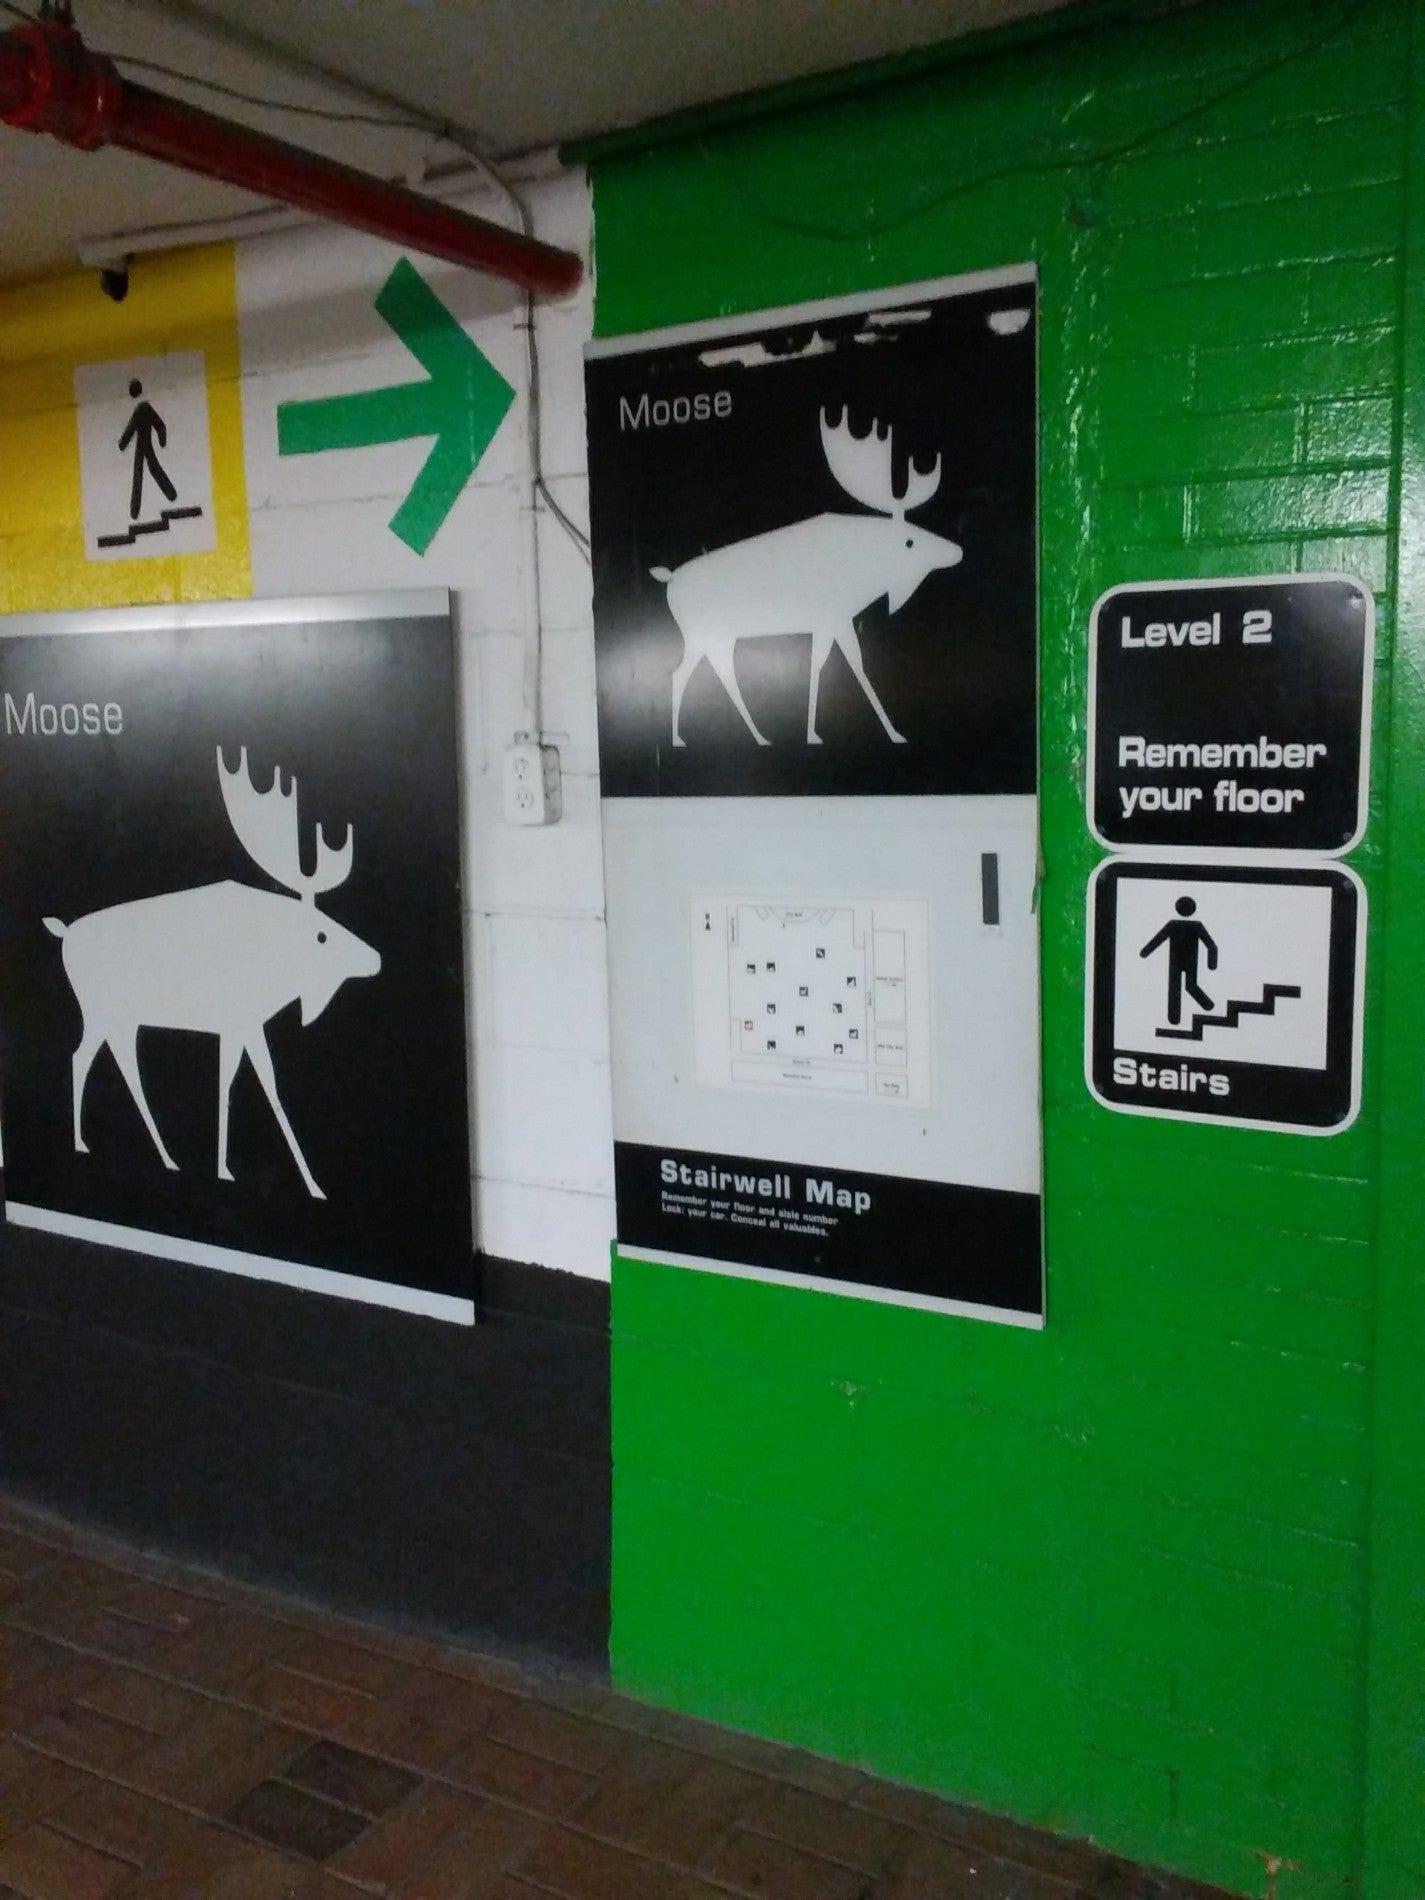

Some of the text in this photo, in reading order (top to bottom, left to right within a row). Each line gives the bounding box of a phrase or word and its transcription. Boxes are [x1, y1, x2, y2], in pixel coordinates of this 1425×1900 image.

[619, 390, 732, 431] Moose
[1121, 609, 1273, 648] Level 2
[4, 692, 123, 735] Moose
[1118, 735, 1328, 769] Remember
[1119, 779, 1305, 819] your floor
[1113, 1056, 1230, 1096] Stairs
[660, 1158, 872, 1215] Stairwell Map
[661, 1190, 708, 1206] Remember
[710, 1200, 731, 1210] your
[733, 1201, 755, 1213] floor
[758, 1206, 776, 1217] and
[802, 1213, 839, 1226] number
[687, 1208, 708, 1218] your
[730, 1212, 767, 1227] Conceal
